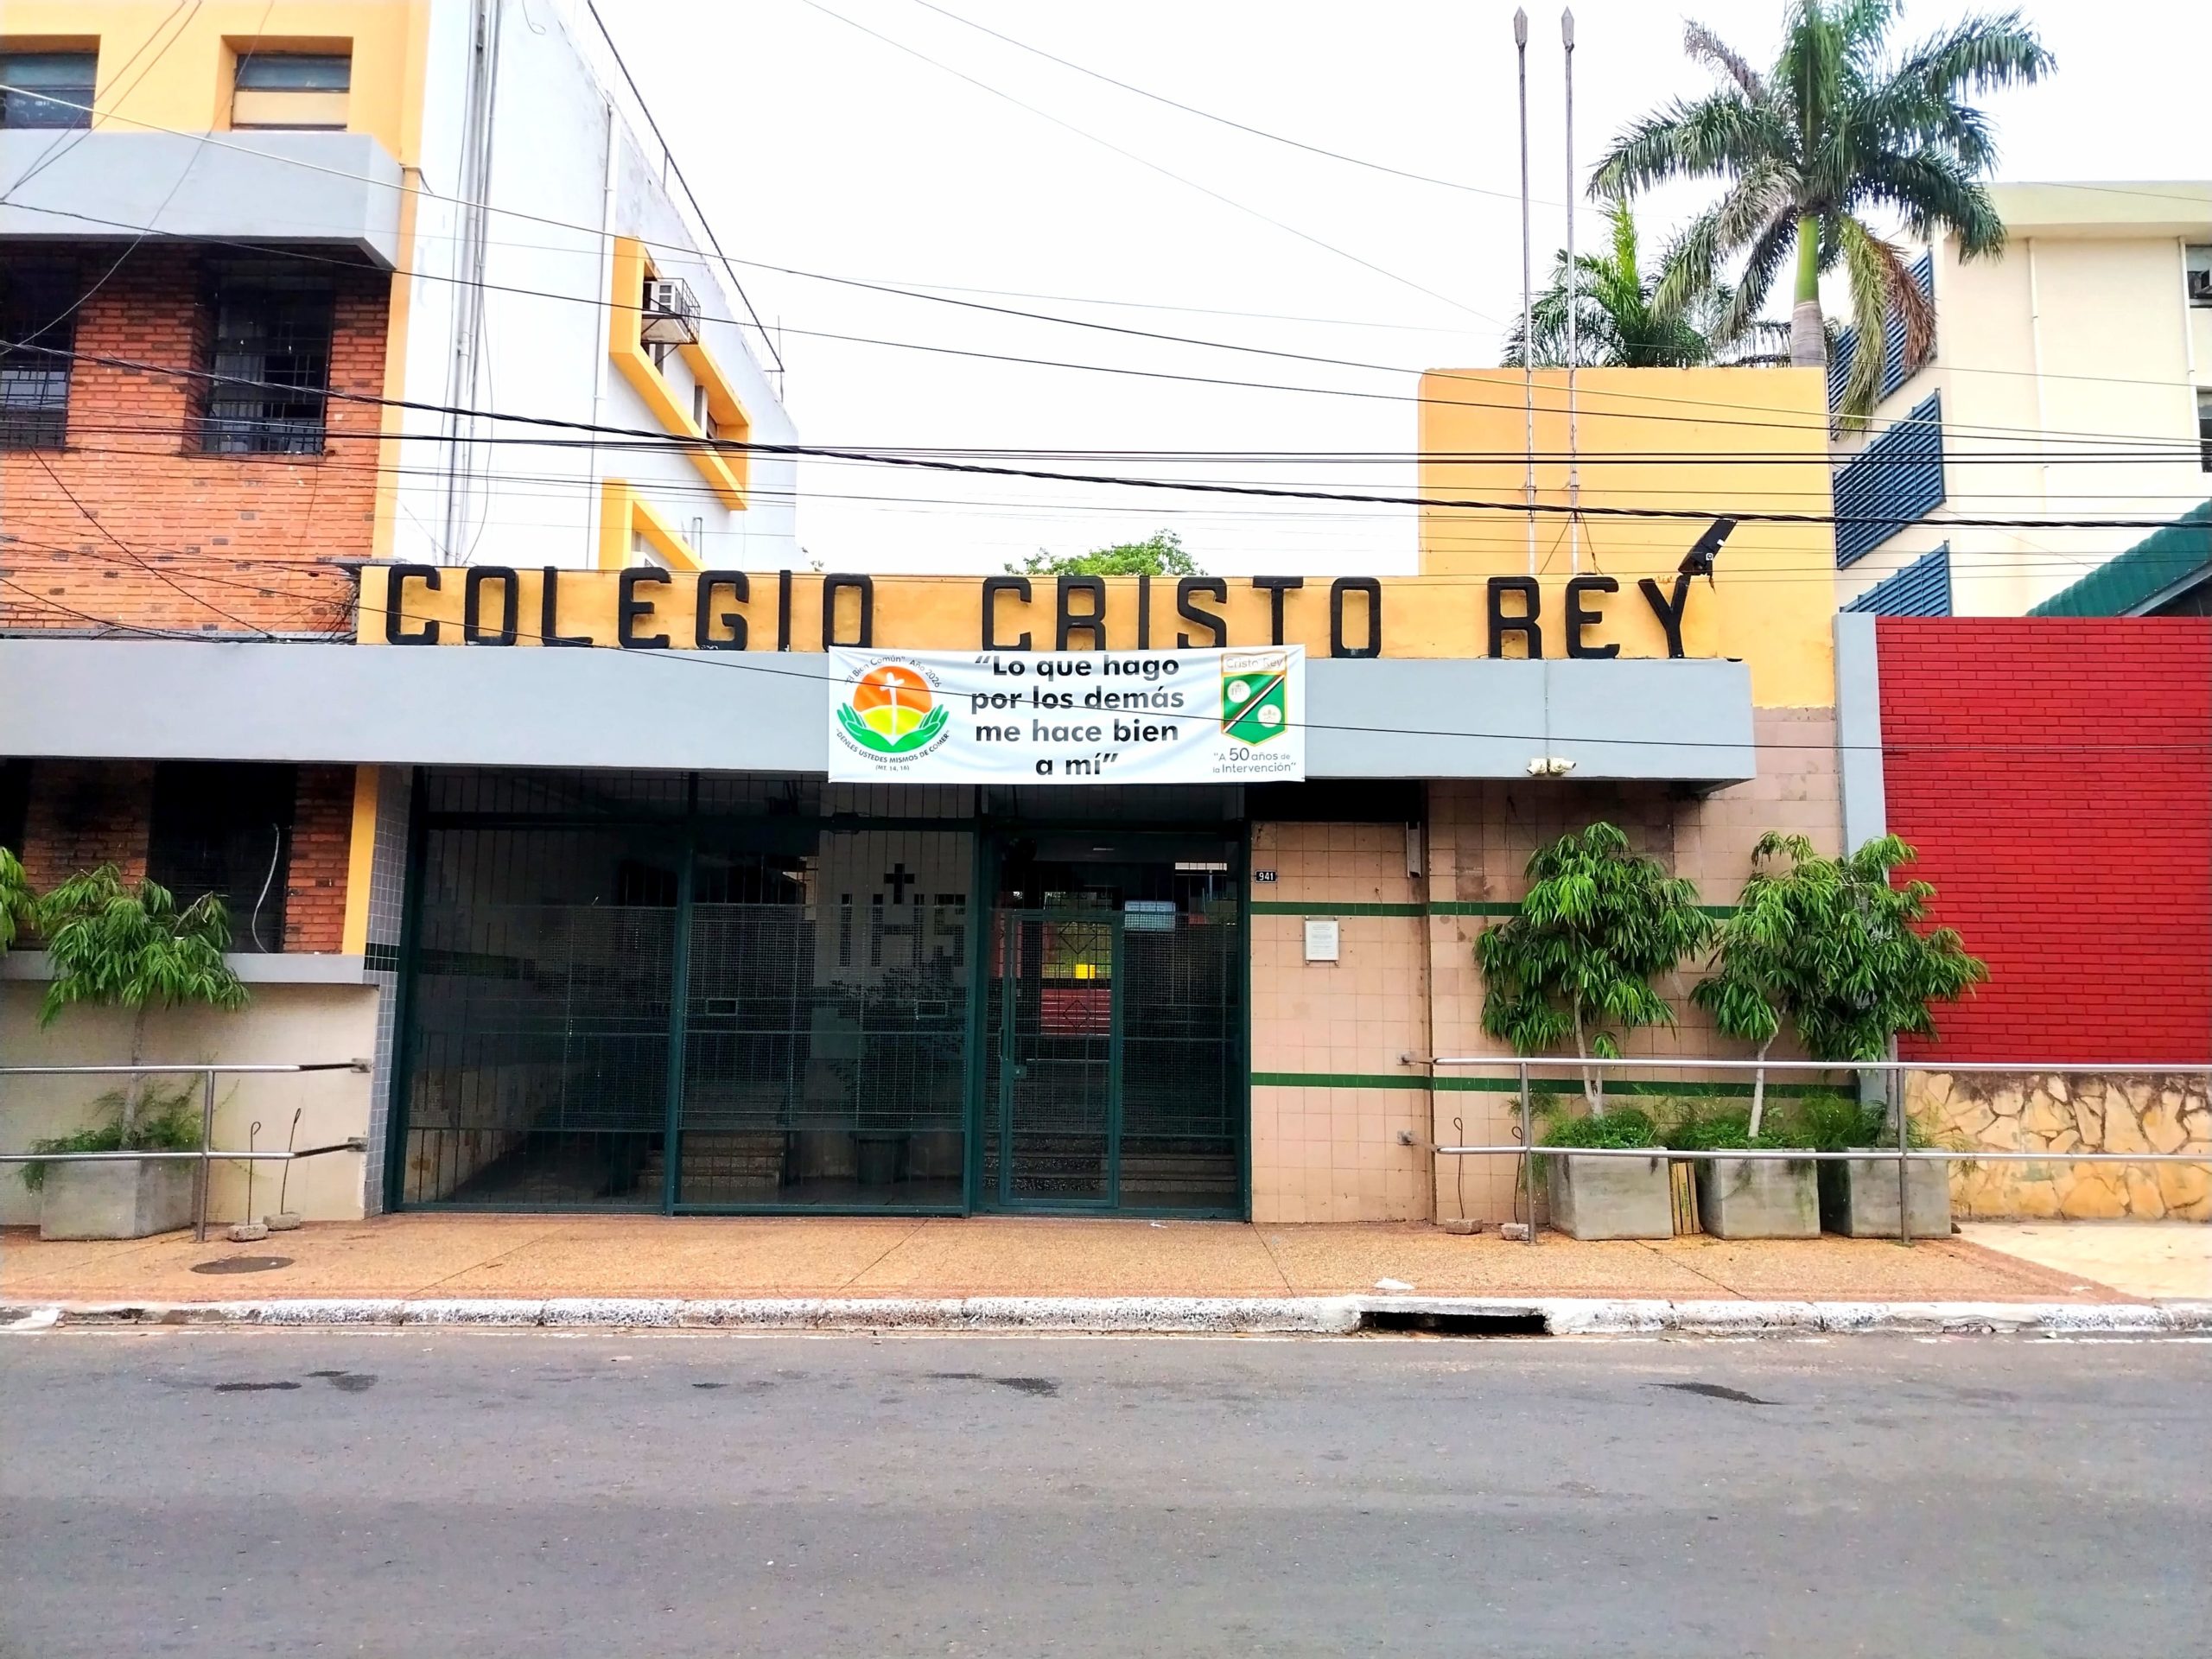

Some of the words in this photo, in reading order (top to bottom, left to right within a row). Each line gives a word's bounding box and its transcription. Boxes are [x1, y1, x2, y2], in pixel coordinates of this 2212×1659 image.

[385, 563, 873, 651] COLEGIO
[982, 575, 1381, 658] CRISTO
[1487, 574, 1691, 658] REY
[852, 664, 869, 677] Bien
[870, 655, 906, 666] Común"
[909, 659, 925, 671] Año
[925, 669, 942, 688] 2026
[975, 655, 1026, 676] "Lo
[1037, 659, 1092, 682] que
[1103, 655, 1179, 681] hago
[1227, 658, 1259, 669] Cristo
[971, 691, 1022, 715] por
[1033, 685, 1073, 709] los
[1084, 685, 1184, 709] demás
[976, 725, 1021, 741] me
[1033, 719, 1102, 741] hace
[1114, 719, 1179, 742] bien
[859, 750, 888, 763] USTEDES
[889, 754, 918, 764] MISMOS
[1036, 759, 1052, 775] a
[1065, 752, 1119, 775] mí"
[1229, 747, 1249, 761] 50
[1251, 749, 1278, 761] años
[1223, 761, 1297, 773] Intervención"
[1259, 872, 1274, 881] 941
